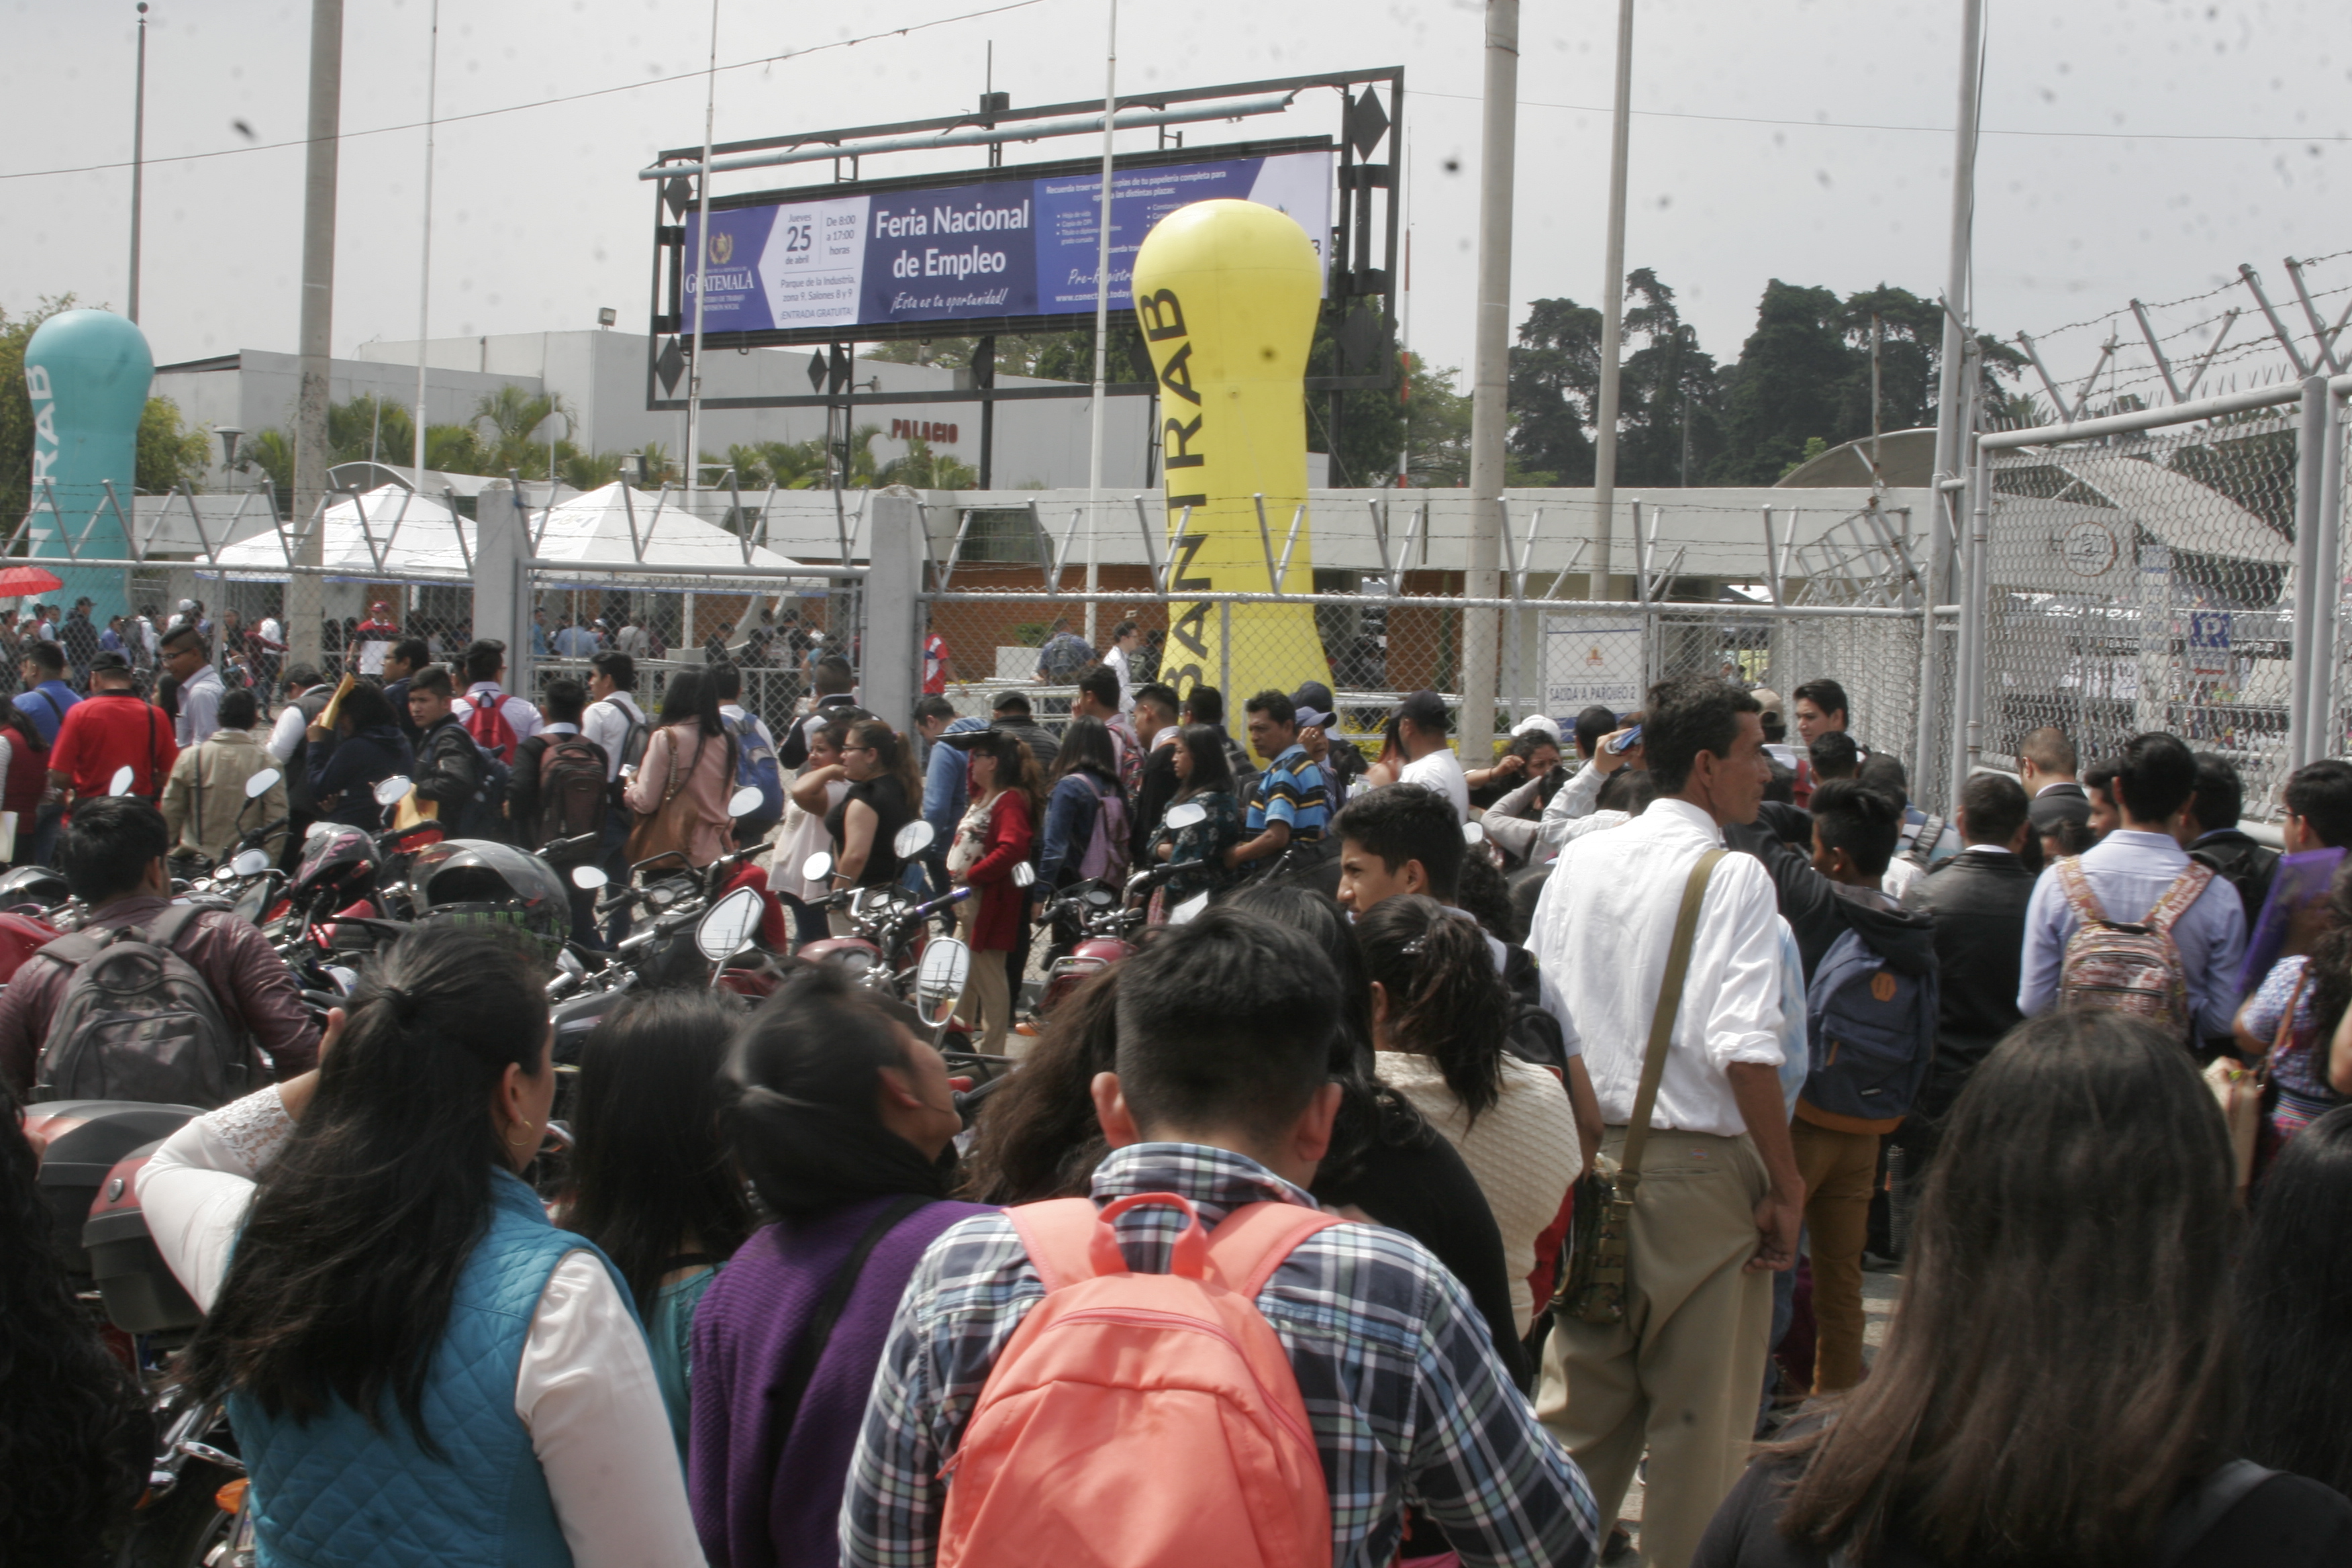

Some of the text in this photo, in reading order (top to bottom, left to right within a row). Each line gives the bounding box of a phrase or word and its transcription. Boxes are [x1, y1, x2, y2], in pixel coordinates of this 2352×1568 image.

[1180, 172, 1210, 181] completa
[1211, 171, 1226, 180] para
[788, 214, 812, 222] Jueves
[826, 215, 856, 226] De 8:00
[875, 199, 1029, 239] Feria Nacional
[787, 225, 812, 252] 25
[833, 230, 854, 241] 17:00
[829, 246, 850, 255] horas
[785, 255, 809, 264] de abril
[893, 245, 1006, 281] de Empleo
[685, 270, 754, 293] GATEMALA
[781, 279, 804, 289] Parque
[805, 277, 814, 287] de
[808, 291, 834, 301] Salones
[934, 295, 943, 307] tu
[946, 288, 1009, 313] oportunidad!
[892, 418, 958, 443] PALACIO
[1140, 288, 1212, 716] BANTRAB
[1550, 687, 1578, 701] SALIDA
[1590, 685, 1629, 701] PARQUEO
